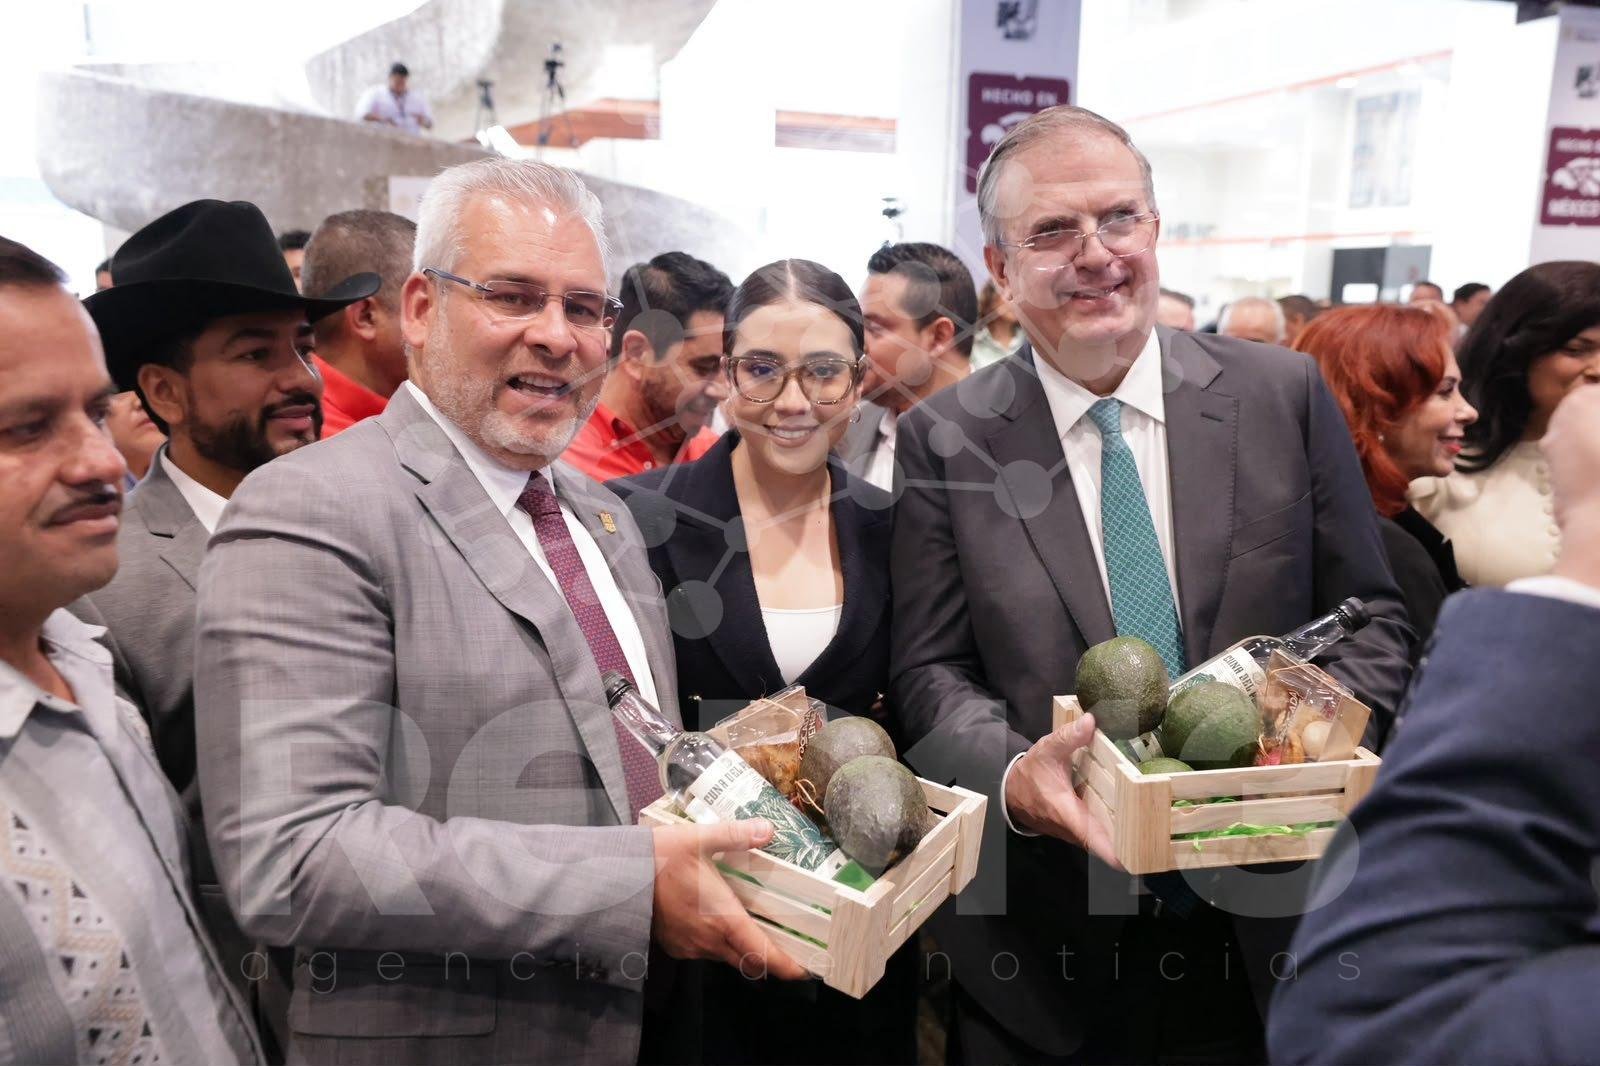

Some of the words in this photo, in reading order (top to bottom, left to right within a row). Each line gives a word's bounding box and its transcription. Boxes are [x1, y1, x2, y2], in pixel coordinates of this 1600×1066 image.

[982, 87, 1034, 106] HECHO
[1223, 655, 1244, 675] CUNA
[1239, 673, 1255, 692] DEL
[703, 778, 729, 806] CUNA
[724, 766, 744, 783] DEL
